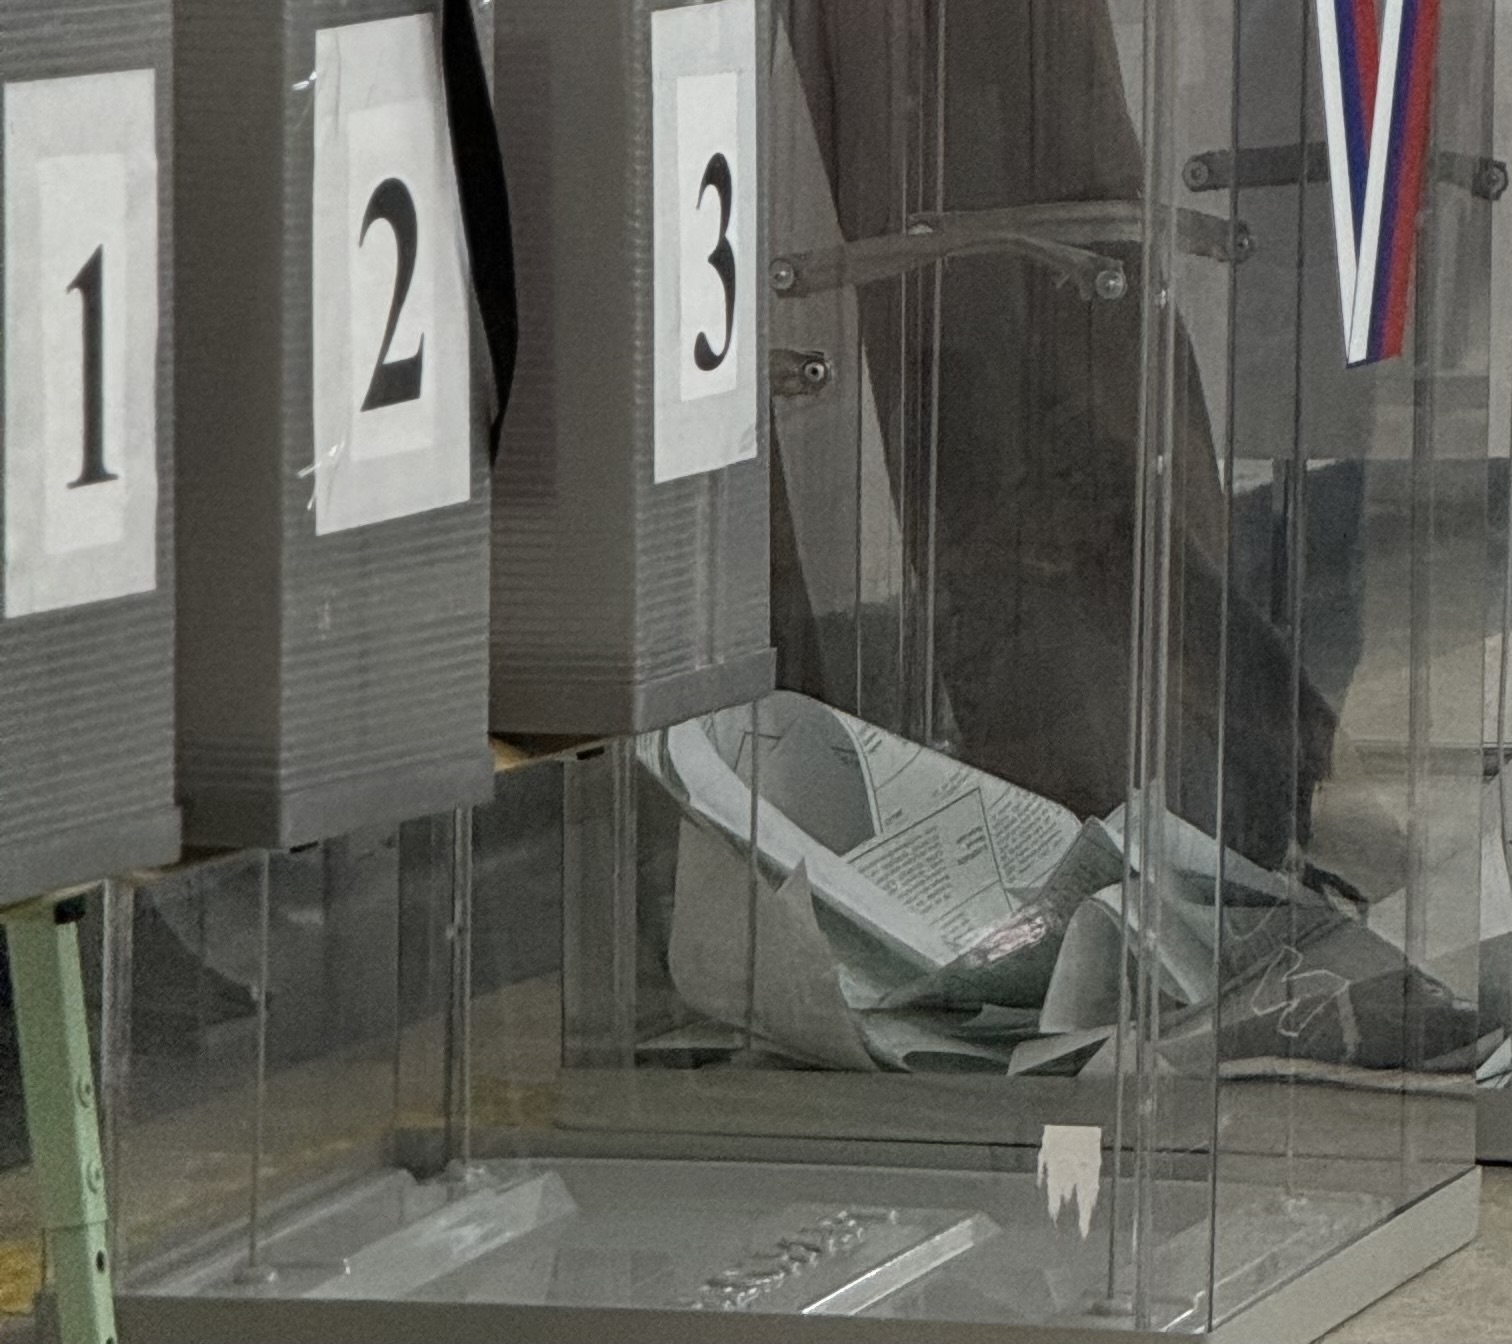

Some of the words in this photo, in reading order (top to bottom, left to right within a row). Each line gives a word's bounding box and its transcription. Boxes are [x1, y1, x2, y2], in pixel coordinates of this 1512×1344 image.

[66, 244, 119, 490] 1
[358, 177, 425, 413] 2
[696, 152, 737, 372] 3
